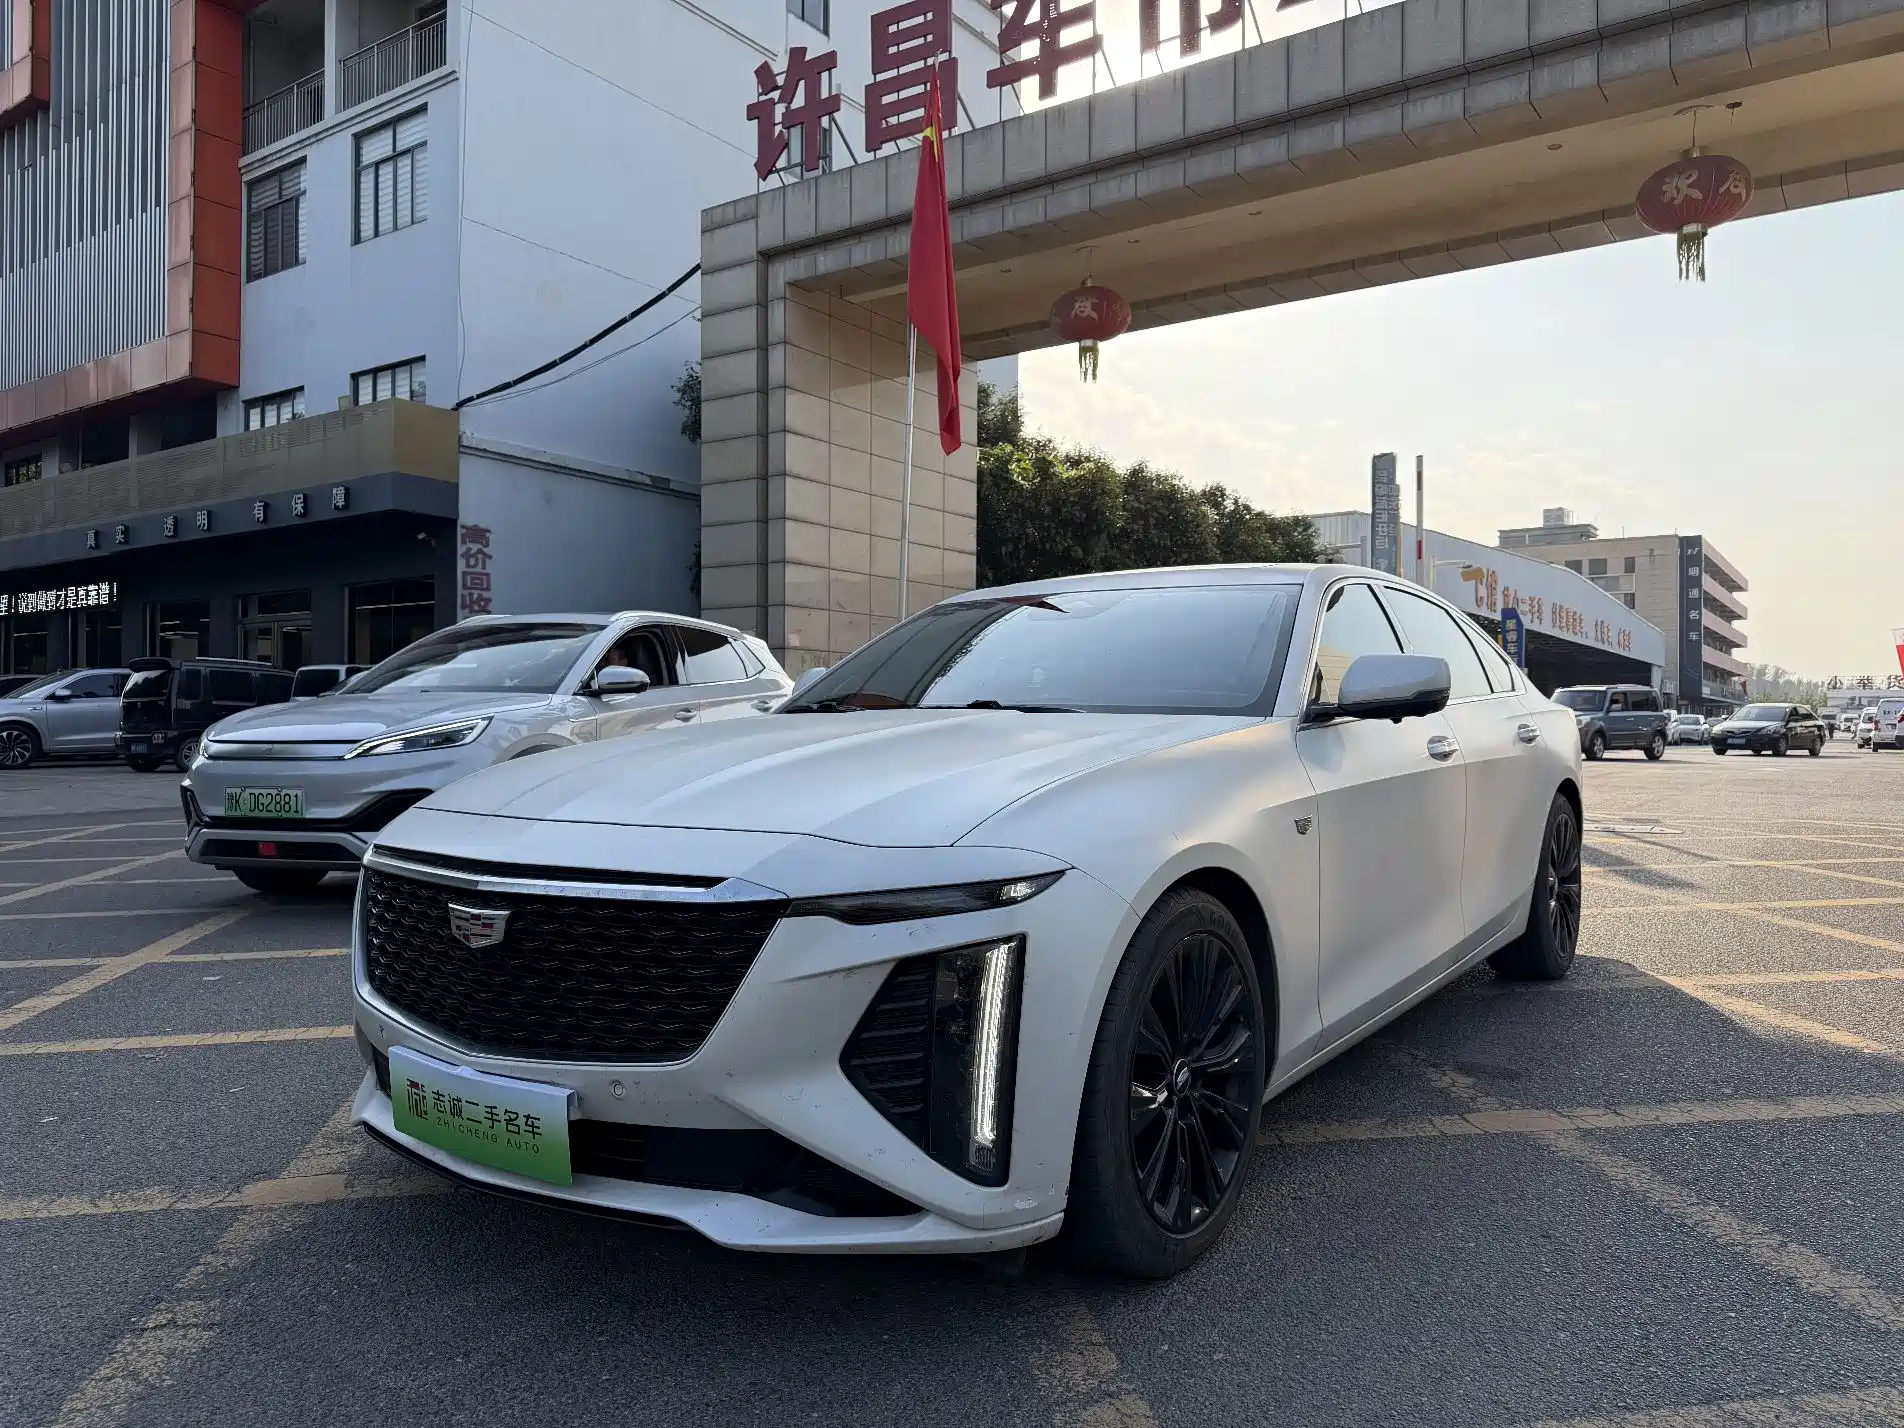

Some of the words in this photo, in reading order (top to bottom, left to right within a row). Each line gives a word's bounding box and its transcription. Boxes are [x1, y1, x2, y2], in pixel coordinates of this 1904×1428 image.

[163, 509, 208, 537] 透明
[253, 486, 346, 522] 有保障
[460, 524, 493, 614] 高价回收
[1688, 566, 1700, 641] 明通名车
[249, 792, 300, 814] DG2881
[432, 1090, 543, 1140] 志诚二手名车
[437, 1116, 498, 1144] ZHICHENG
[506, 1138, 540, 1154] AUTO
